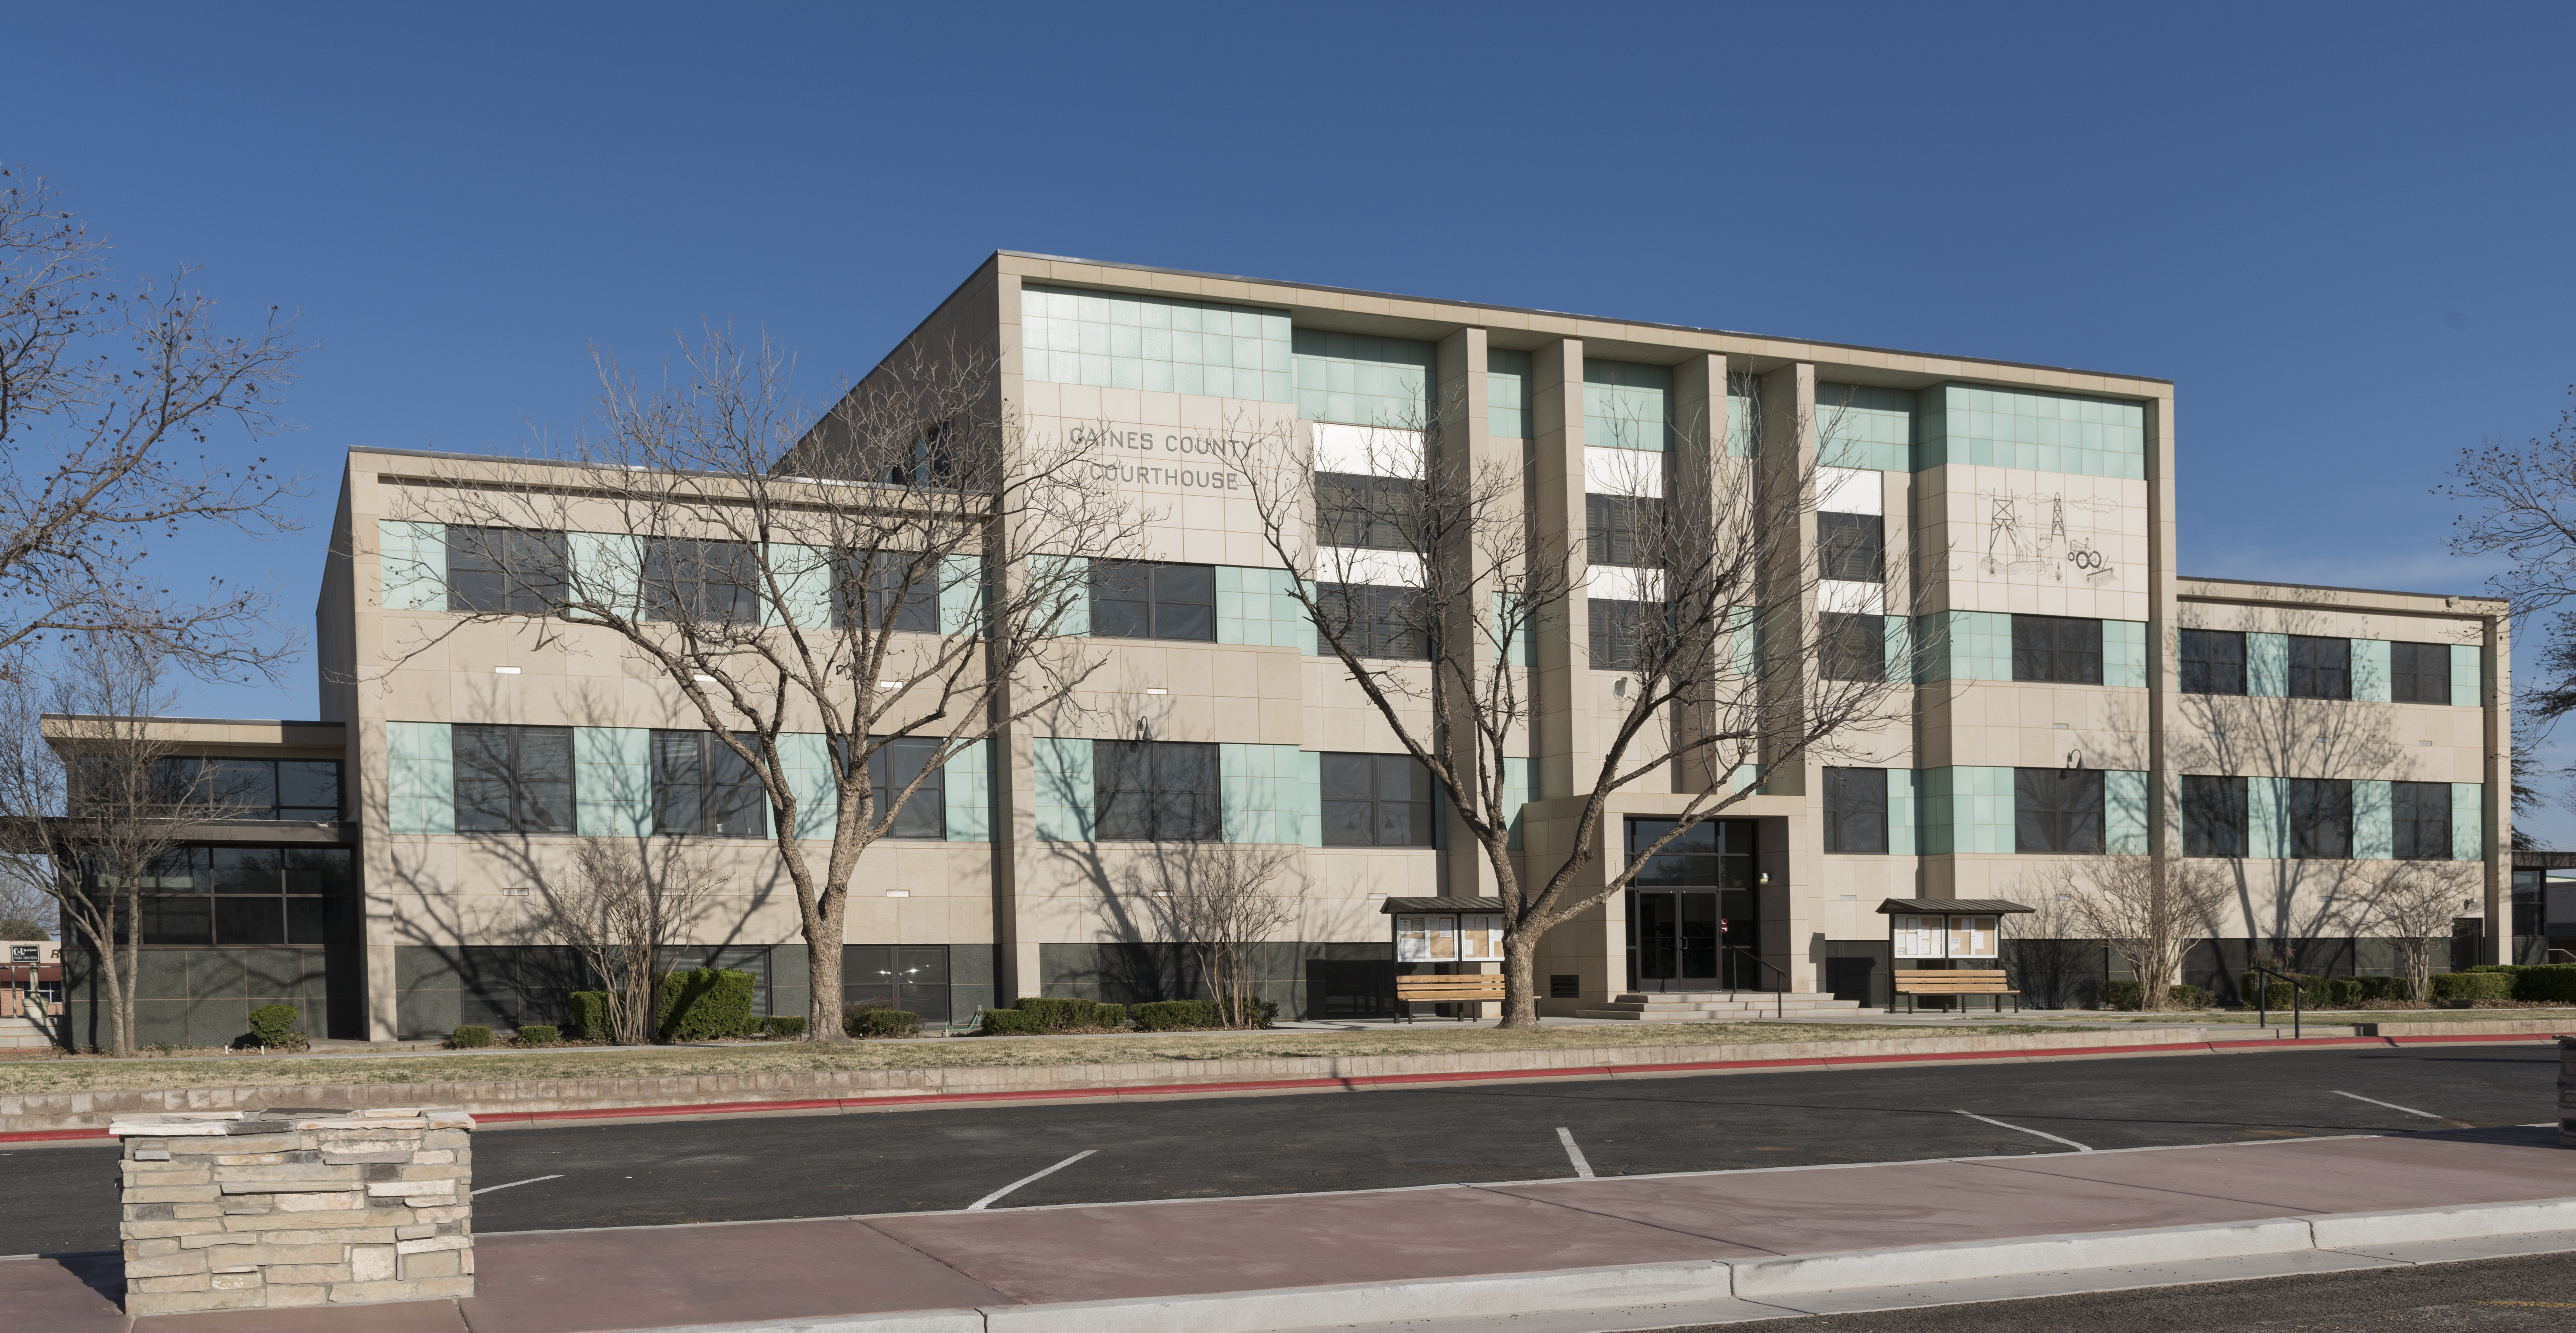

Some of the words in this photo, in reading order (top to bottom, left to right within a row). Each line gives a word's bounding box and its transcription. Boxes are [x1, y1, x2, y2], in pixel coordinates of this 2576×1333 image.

[1071, 427, 1153, 450] GAINES
[1166, 435, 1254, 458] COUNTY
[1090, 463, 1238, 490] COURTHOUSE
